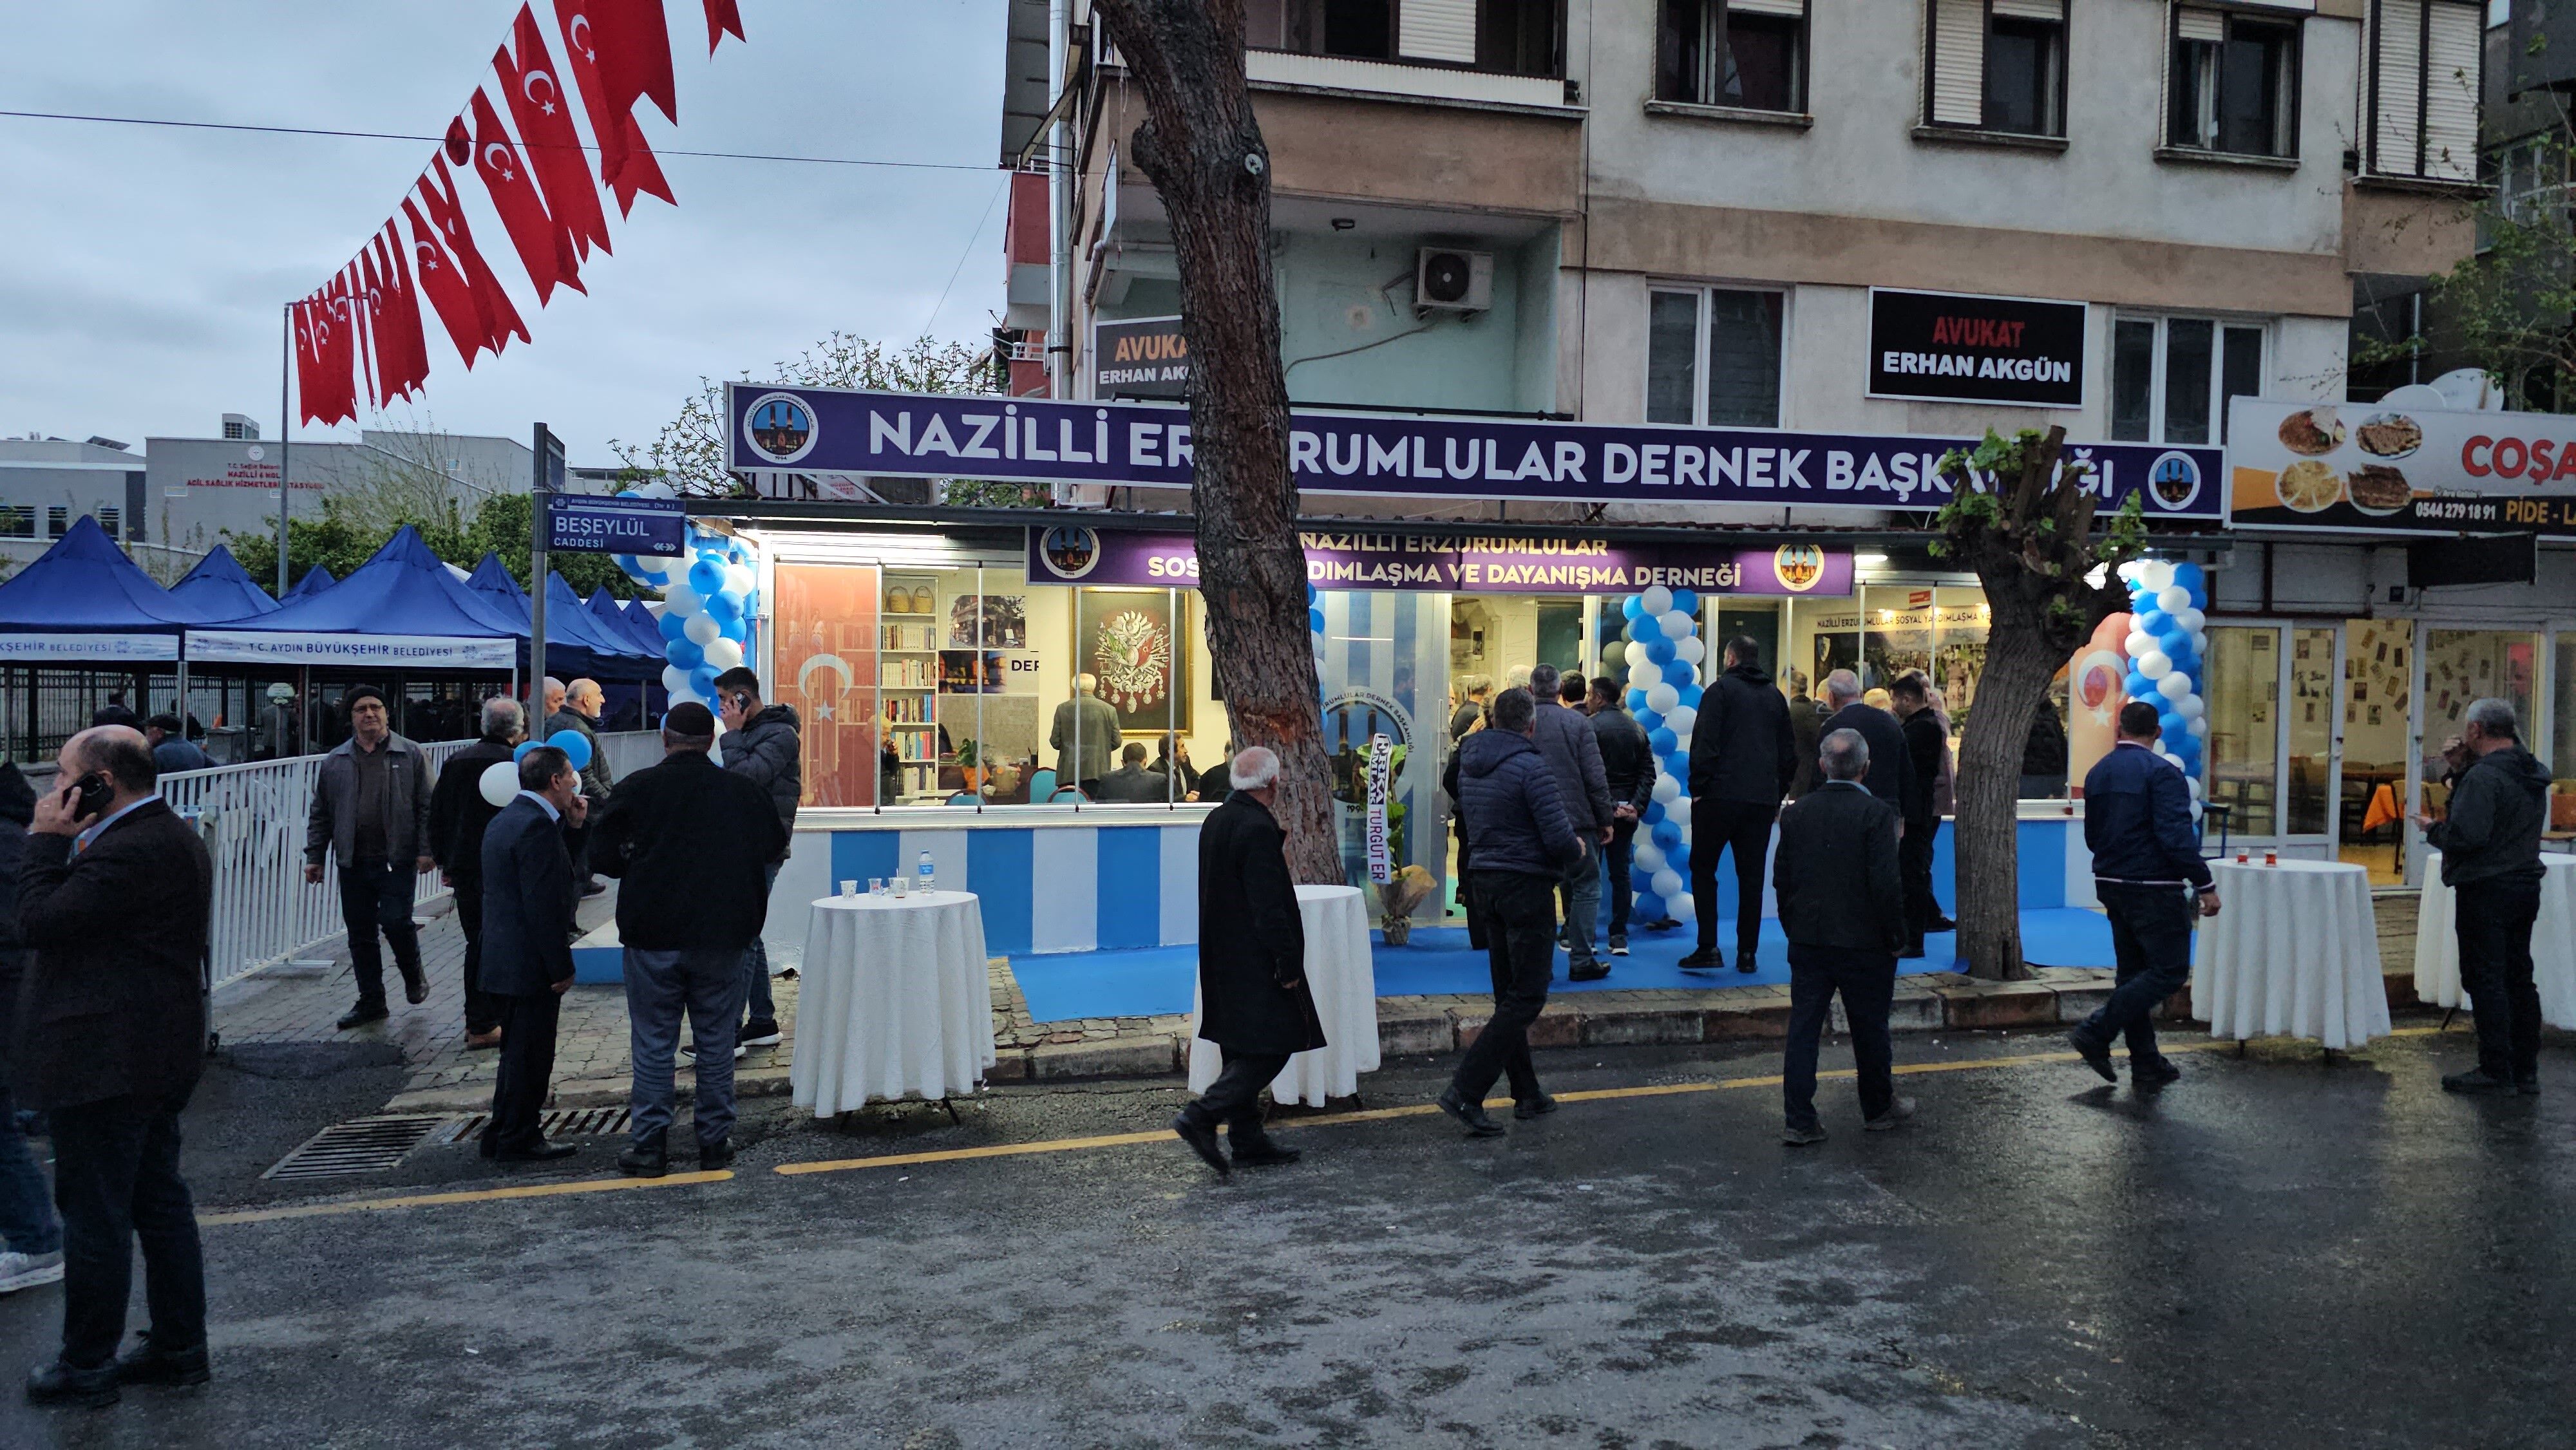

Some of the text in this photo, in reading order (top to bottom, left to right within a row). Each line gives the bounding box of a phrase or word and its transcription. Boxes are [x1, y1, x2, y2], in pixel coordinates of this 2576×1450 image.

[1933, 316, 2025, 348] AVUKAT
[1115, 334, 1188, 362] AVUKA
[1099, 368, 1157, 384] ERHAN
[1884, 351, 2071, 382] ERHAN AKGÜN
[870, 404, 1108, 464] NAZİLLİ
[1130, 422, 1587, 483] ERRUMLULAR
[1604, 442, 1812, 489] DERNEK
[2416, 502, 2496, 520] 0544 279 18 91
[2506, 494, 2549, 523] PİDE
[556, 516, 650, 536] BEŞEYLÜL
[554, 537, 604, 548] CADDESİ
[1405, 535, 1607, 556] ERZURUMLULAR
[1448, 563, 1480, 583] VE
[1488, 564, 1628, 590] DAYANIŞMA
[1634, 563, 1741, 587] DERNEĞİ
[1896, 615, 1922, 625] SOSYAL
[50, 643, 111, 652] BELEDİYESİ
[270, 643, 303, 652] AYDIN
[307, 641, 389, 657] BÜYÜKŞEHİR
[393, 646, 452, 656] BELEDİYESİ
[1366, 693, 1394, 710] DERNEK
[1370, 809, 1385, 880] TURGUT ER
